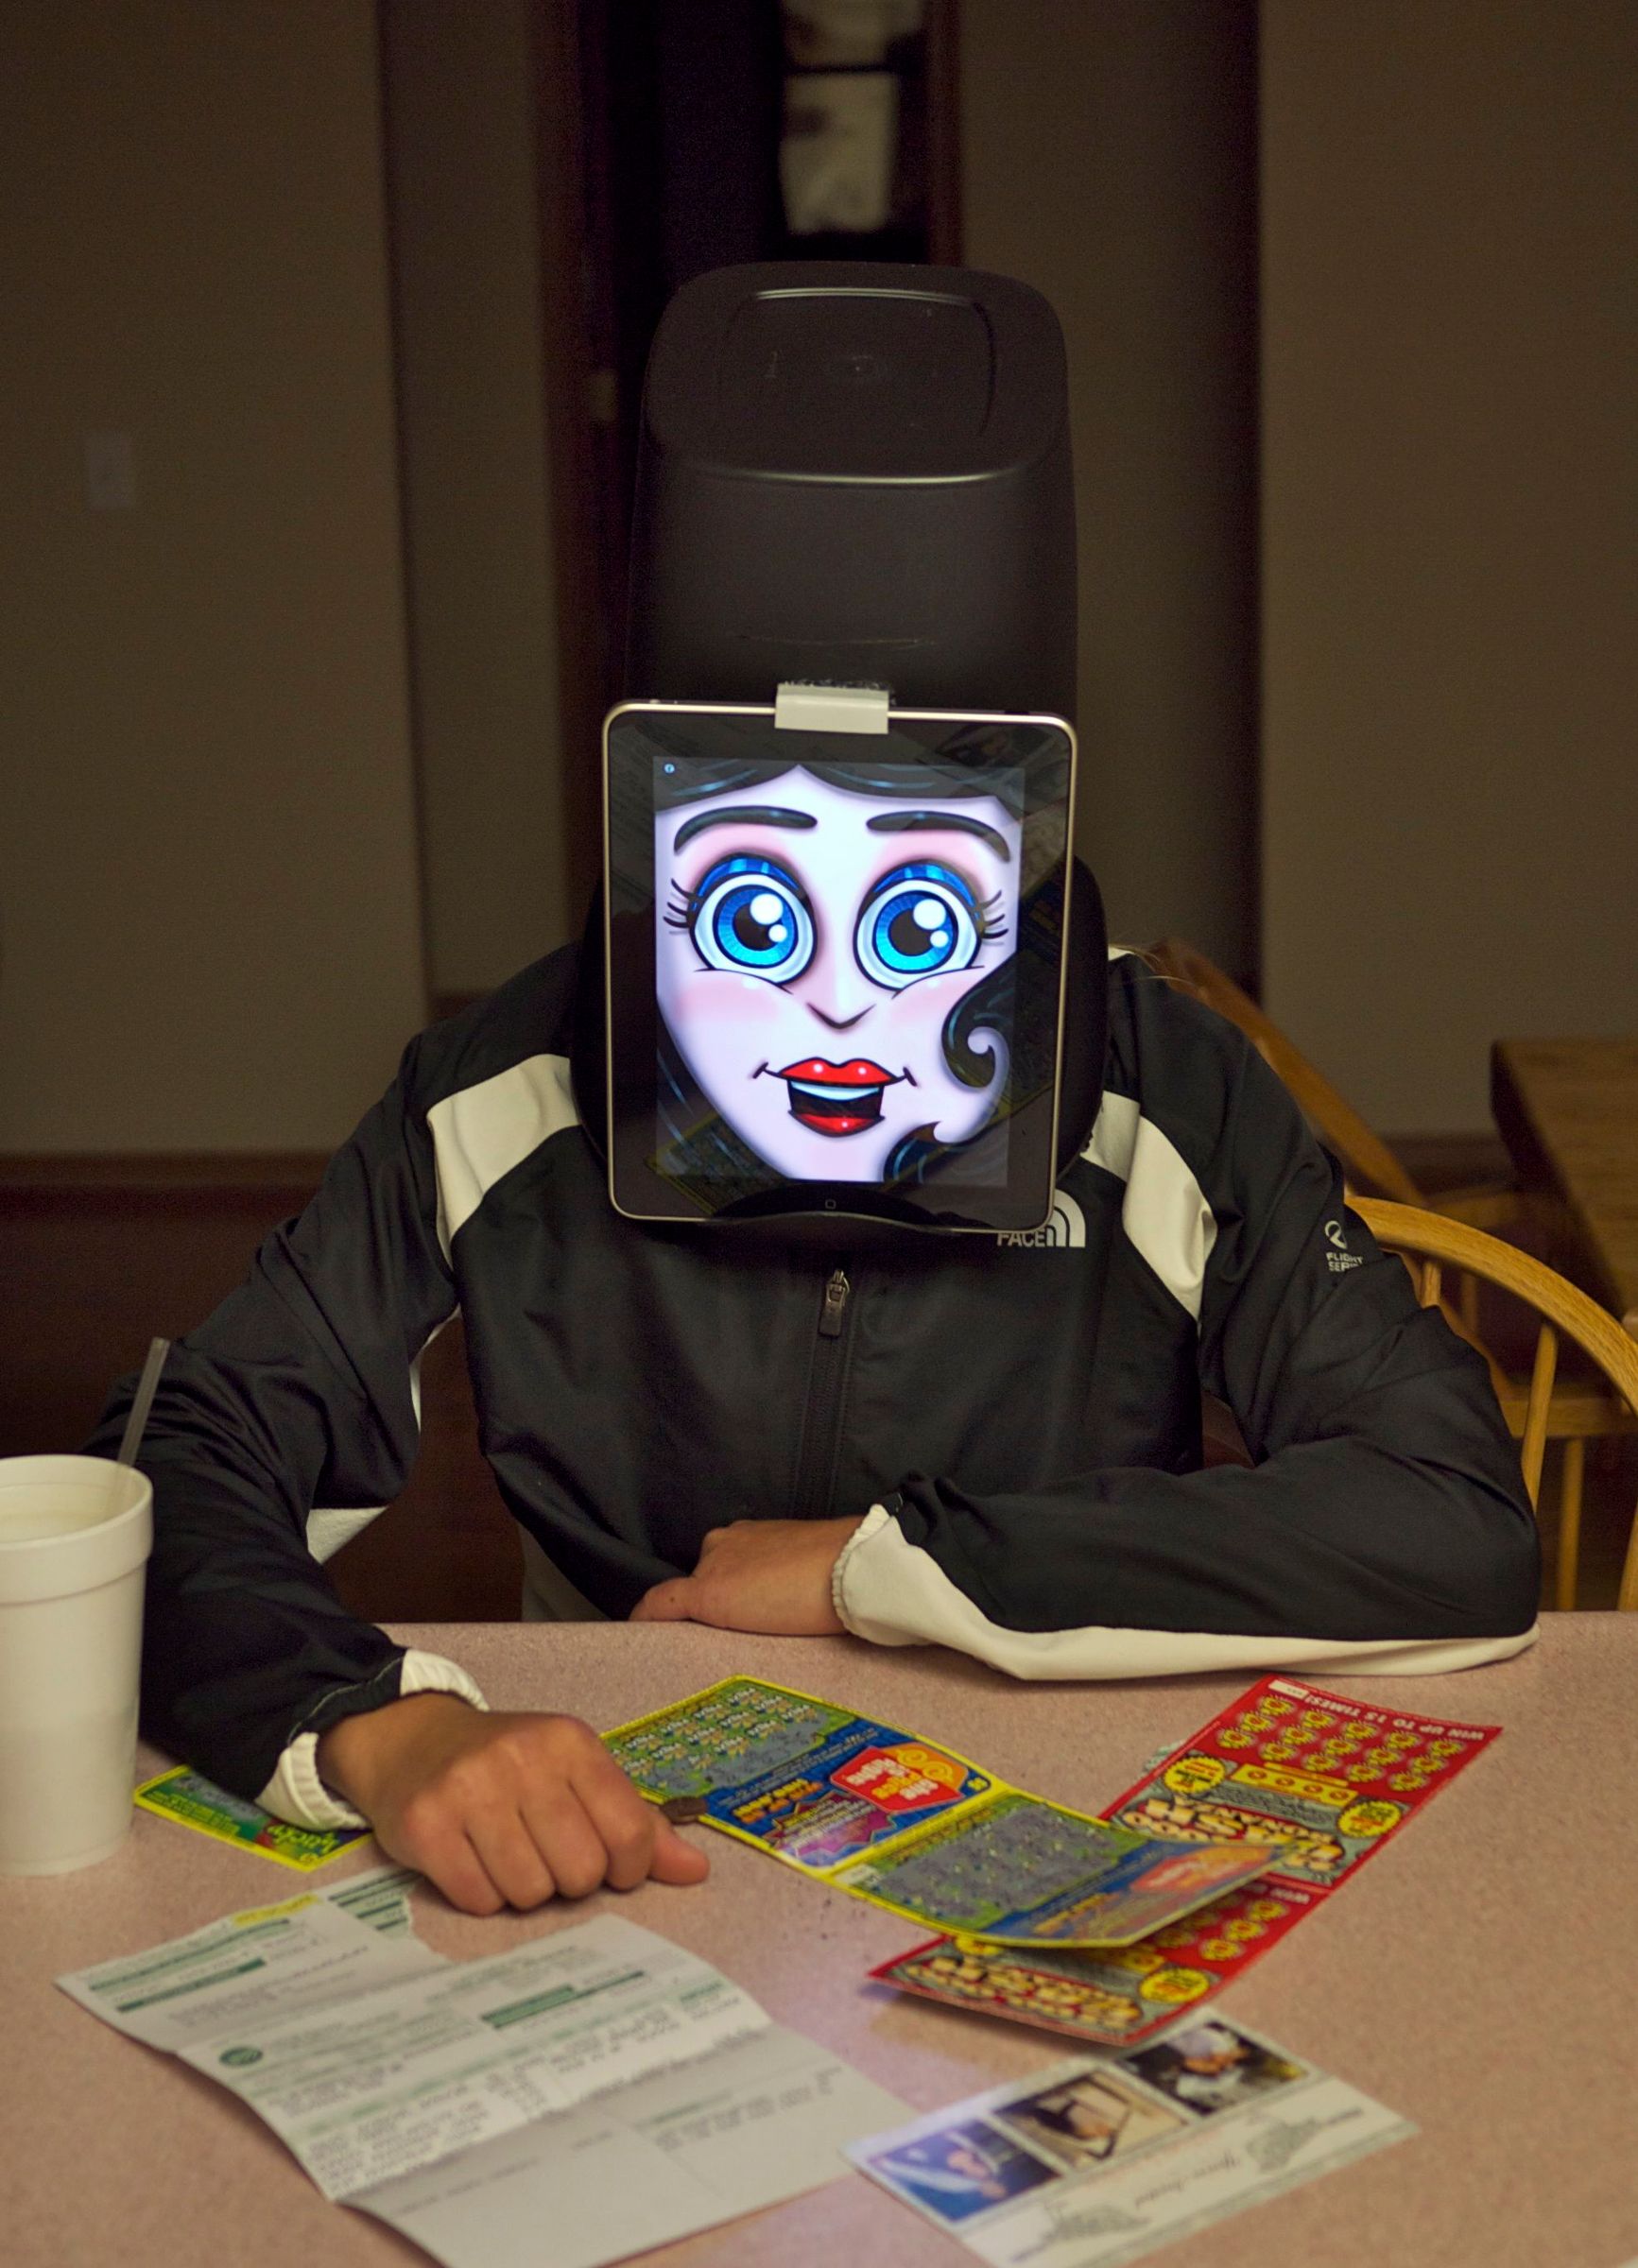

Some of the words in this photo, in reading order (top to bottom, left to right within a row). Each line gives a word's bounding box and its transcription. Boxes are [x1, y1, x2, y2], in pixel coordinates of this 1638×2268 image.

[996, 1229, 1045, 1247] FACE
[1326, 1251, 1363, 1264] FLIGHT
[1364, 1711, 1388, 1724] 15
[1392, 1718, 1416, 1729] TO
[1419, 1723, 1445, 1735] UP
[1447, 1727, 1485, 1741] WIN
